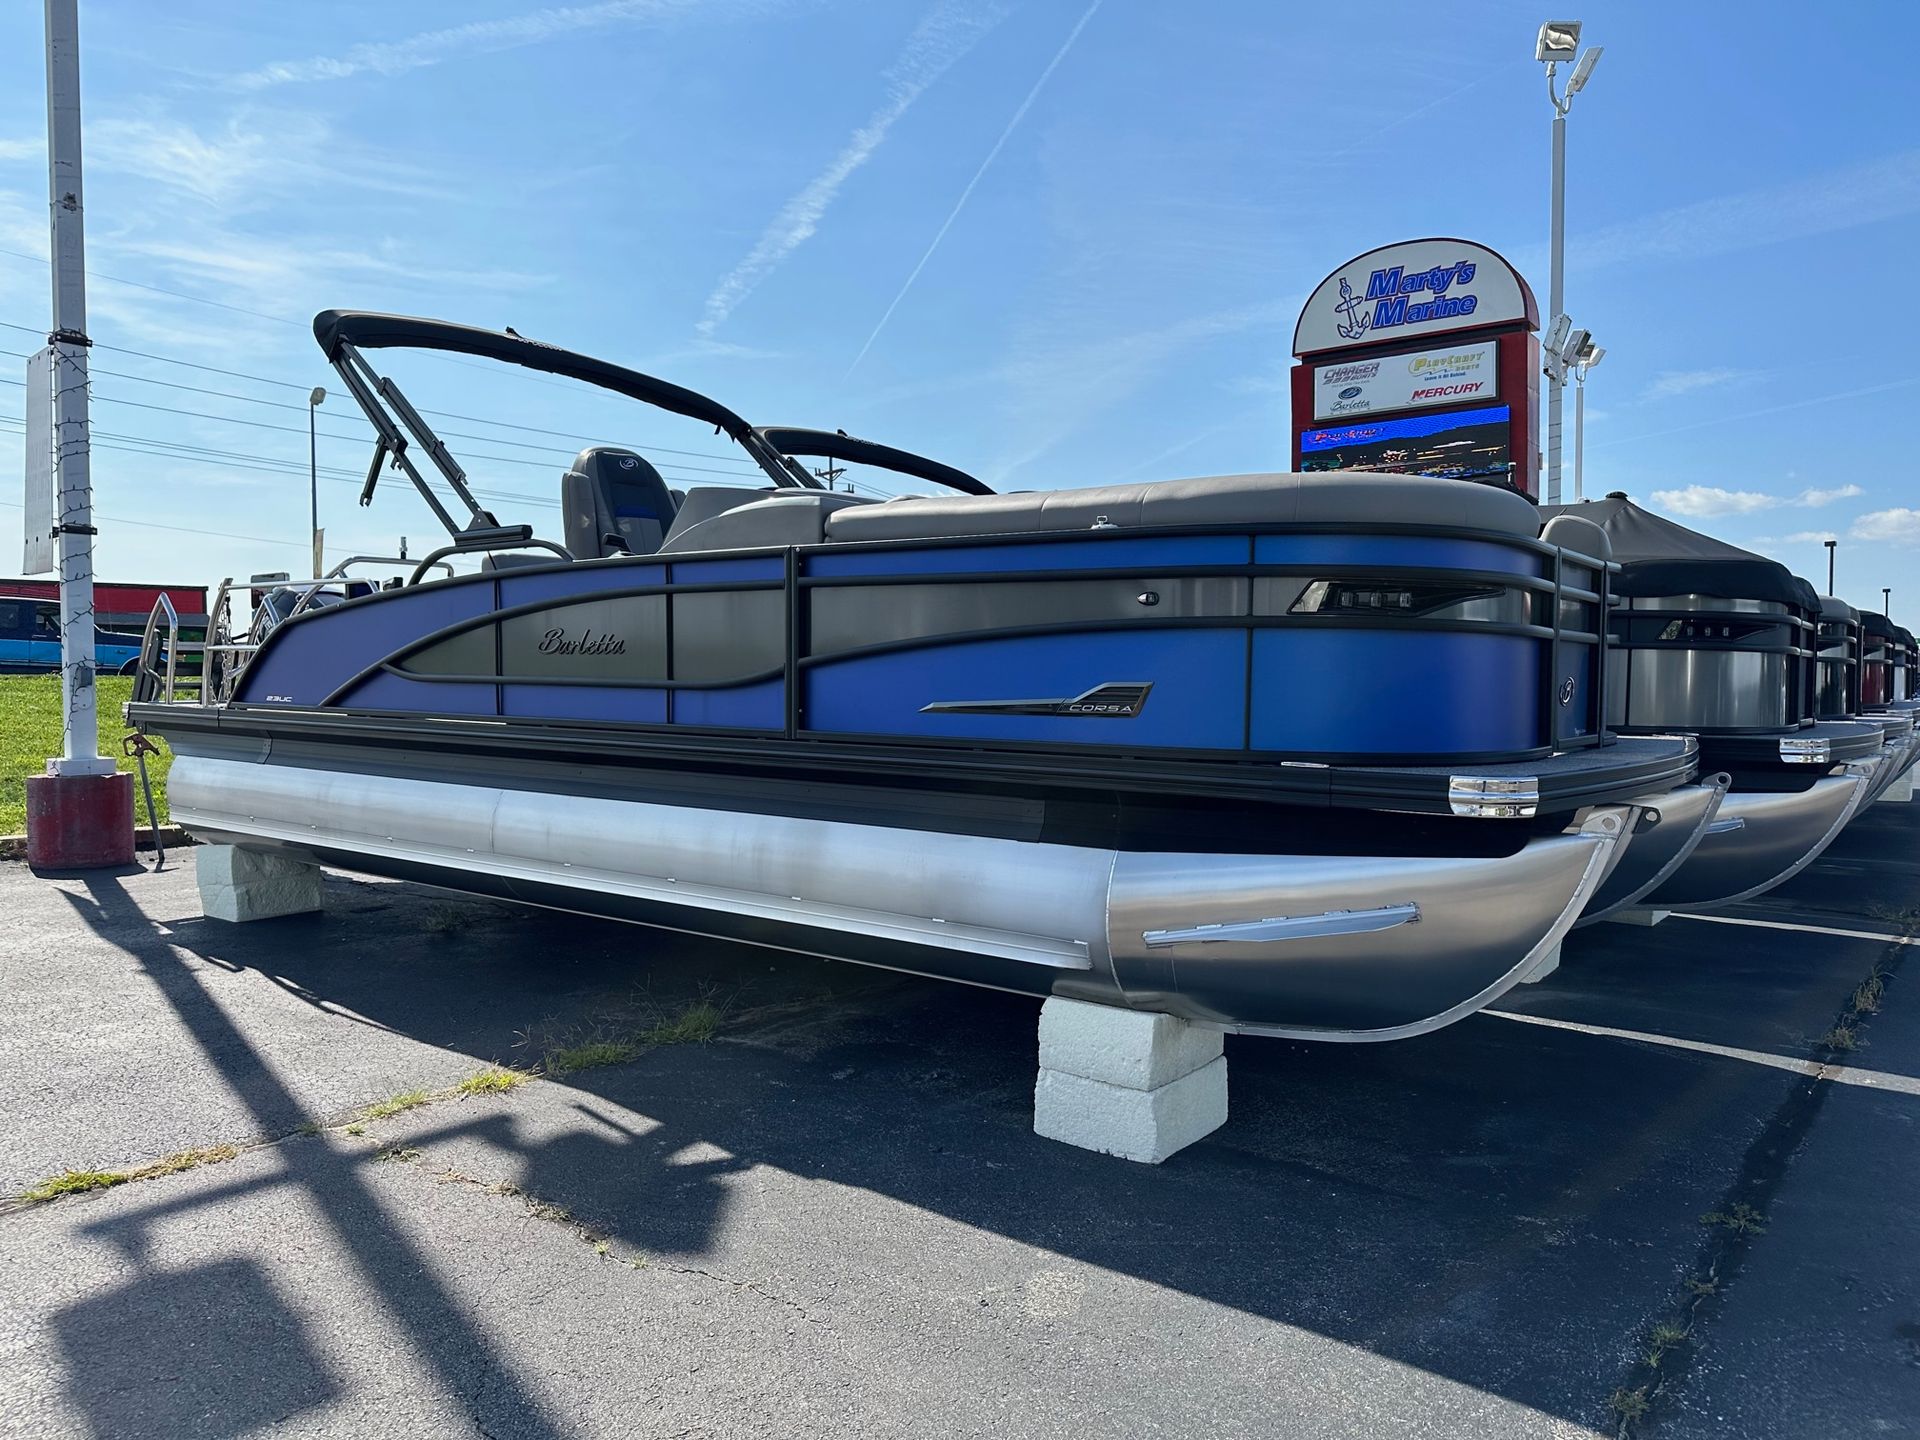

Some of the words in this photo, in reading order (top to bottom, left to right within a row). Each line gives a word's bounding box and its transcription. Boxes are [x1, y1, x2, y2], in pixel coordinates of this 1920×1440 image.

[1365, 260, 1477, 301] Marty's
[1370, 295, 1478, 330] Marine
[1323, 362, 1380, 380] CHARGER
[1411, 382, 1485, 400] MERCURY
[1330, 400, 1370, 412] Barletta
[538, 627, 626, 656] Barletta
[1069, 704, 1132, 712] CORSA
